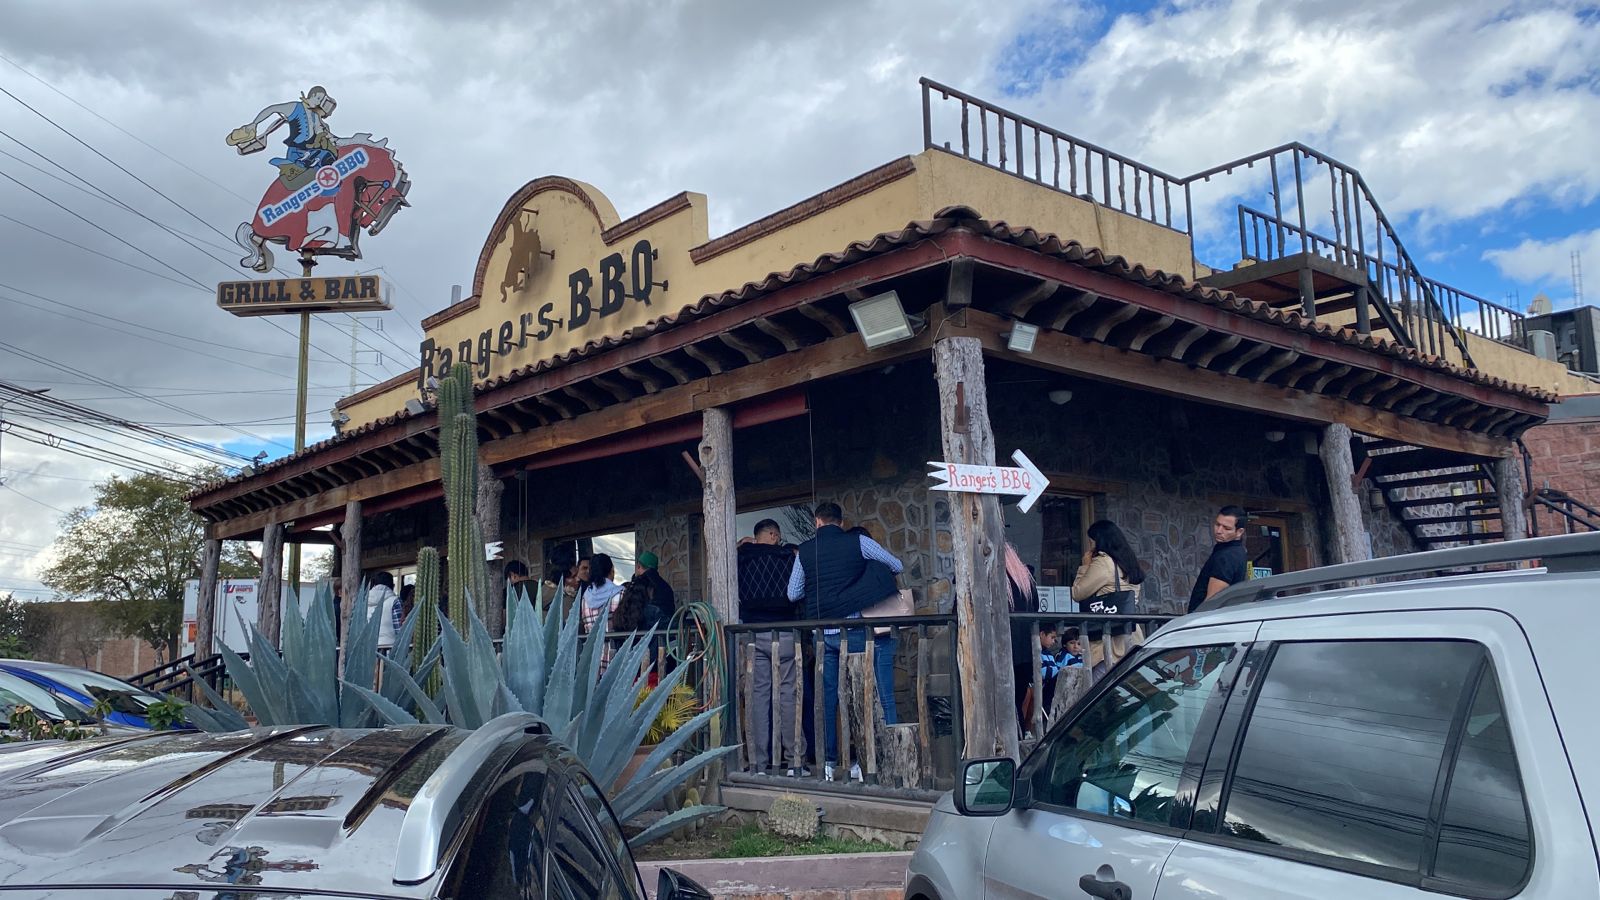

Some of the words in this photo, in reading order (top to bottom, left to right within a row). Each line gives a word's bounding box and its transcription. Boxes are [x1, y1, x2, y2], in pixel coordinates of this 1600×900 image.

[262, 183, 321, 223] Rangers
[336, 150, 365, 177] BBQ
[220, 282, 291, 304] GRILL
[298, 281, 316, 300] &
[325, 277, 376, 300] BAR
[417, 303, 554, 390] Rangers
[568, 239, 652, 332] BBQ
[1001, 469, 1031, 490] BBQ
